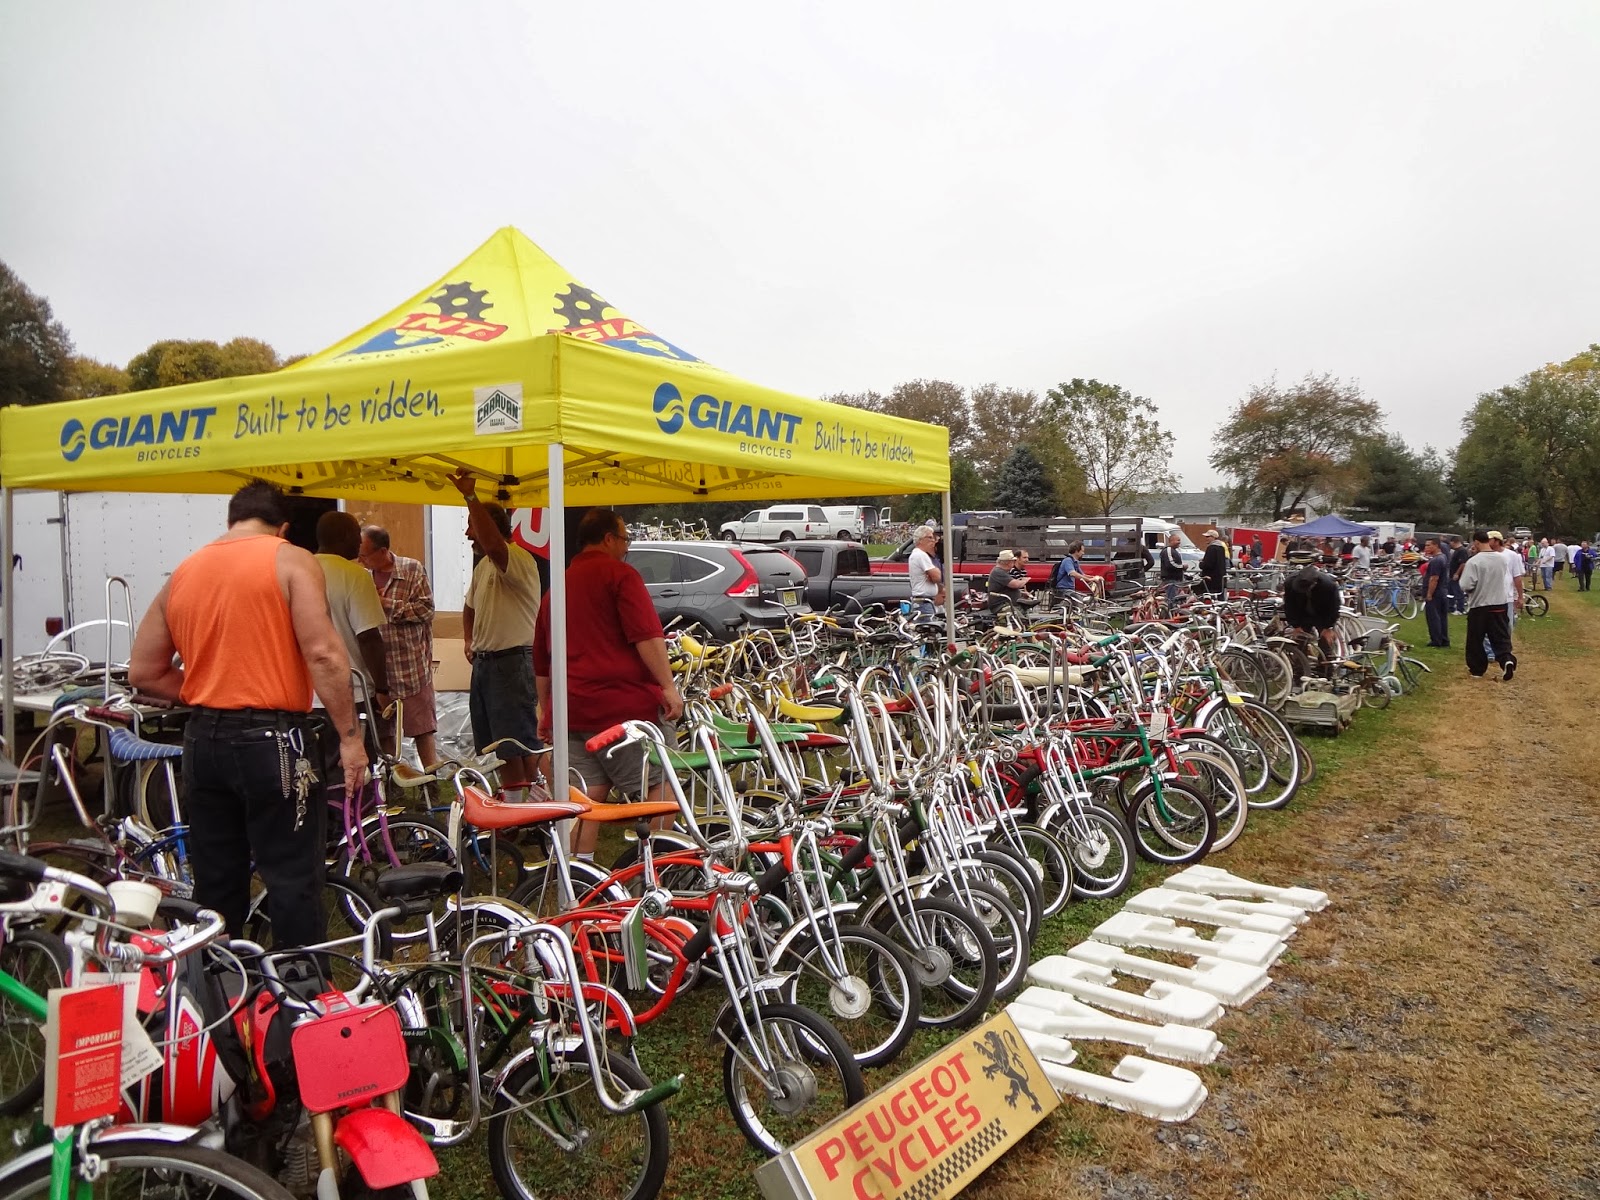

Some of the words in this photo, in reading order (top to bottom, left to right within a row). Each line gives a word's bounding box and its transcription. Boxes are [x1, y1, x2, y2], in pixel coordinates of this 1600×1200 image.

[89, 407, 217, 450] GIANT
[234, 396, 289, 439] Built
[296, 398, 318, 432] to
[324, 393, 351, 429] be
[360, 379, 446, 422] ridden.
[477, 392, 519, 423] CARAVAN
[688, 394, 803, 444] GIANT
[814, 421, 847, 454] Built
[850, 430, 862, 456] to
[865, 431, 878, 459] be
[881, 433, 916, 465] ridden.
[137, 446, 201, 462] BICYCLES
[739, 442, 793, 460] BICYCLES
[1092, 757, 1140, 775] CHOPPER
[75, 1029, 121, 1049] IMPORTANT!
[337, 1083, 378, 1099] HONDA
[814, 1051, 972, 1182] PEUGEOT
[851, 1092, 983, 1200] CYCLES
